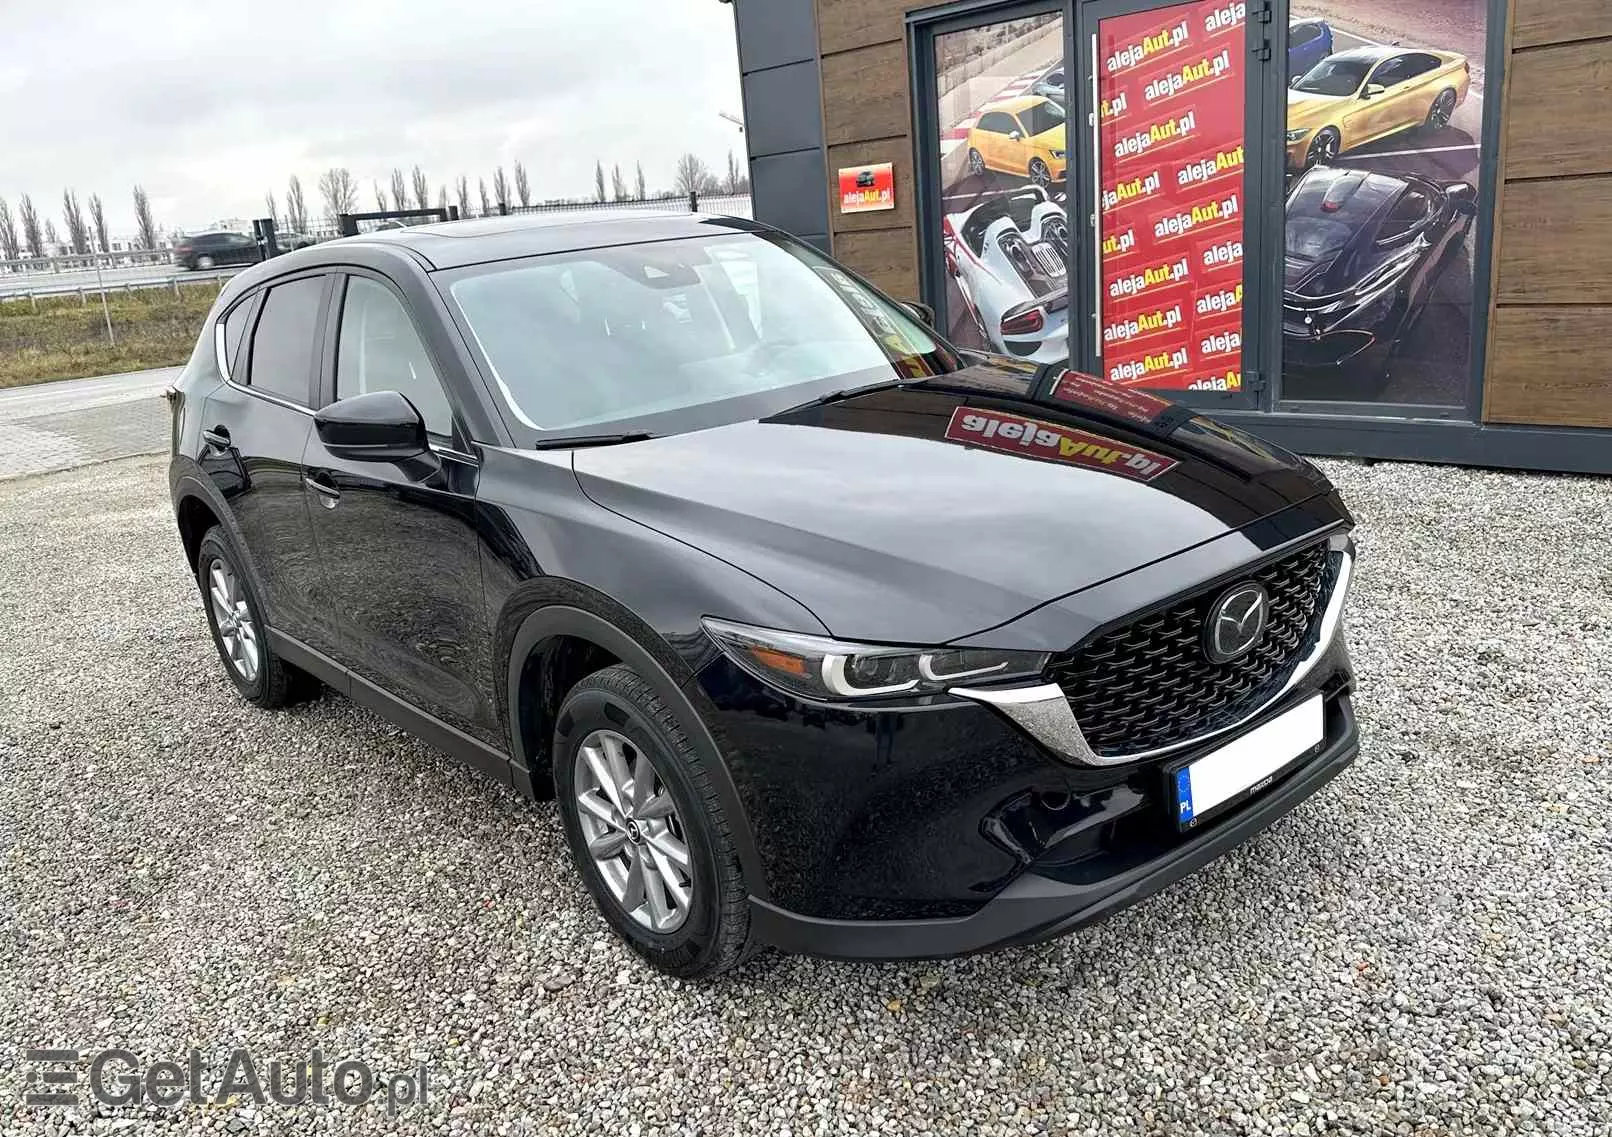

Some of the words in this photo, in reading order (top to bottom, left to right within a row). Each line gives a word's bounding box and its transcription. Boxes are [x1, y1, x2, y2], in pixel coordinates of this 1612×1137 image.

[1106, 20, 1189, 72] alejaAut.pl
[1144, 50, 1230, 101] alejaAut.pl
[1114, 110, 1196, 158] alejaAut.pl
[1177, 144, 1244, 185] alejaAut
[843, 187, 891, 208] alejaAut.pl
[1101, 170, 1161, 211] jaAut.pl
[1153, 194, 1238, 237] alejaAut.pl
[1109, 257, 1189, 297] alejaAut.pl
[1104, 304, 1182, 341] alejaAut.pl
[1109, 347, 1189, 381] alejaAut.pl
[1179, 799, 1192, 815] PL
